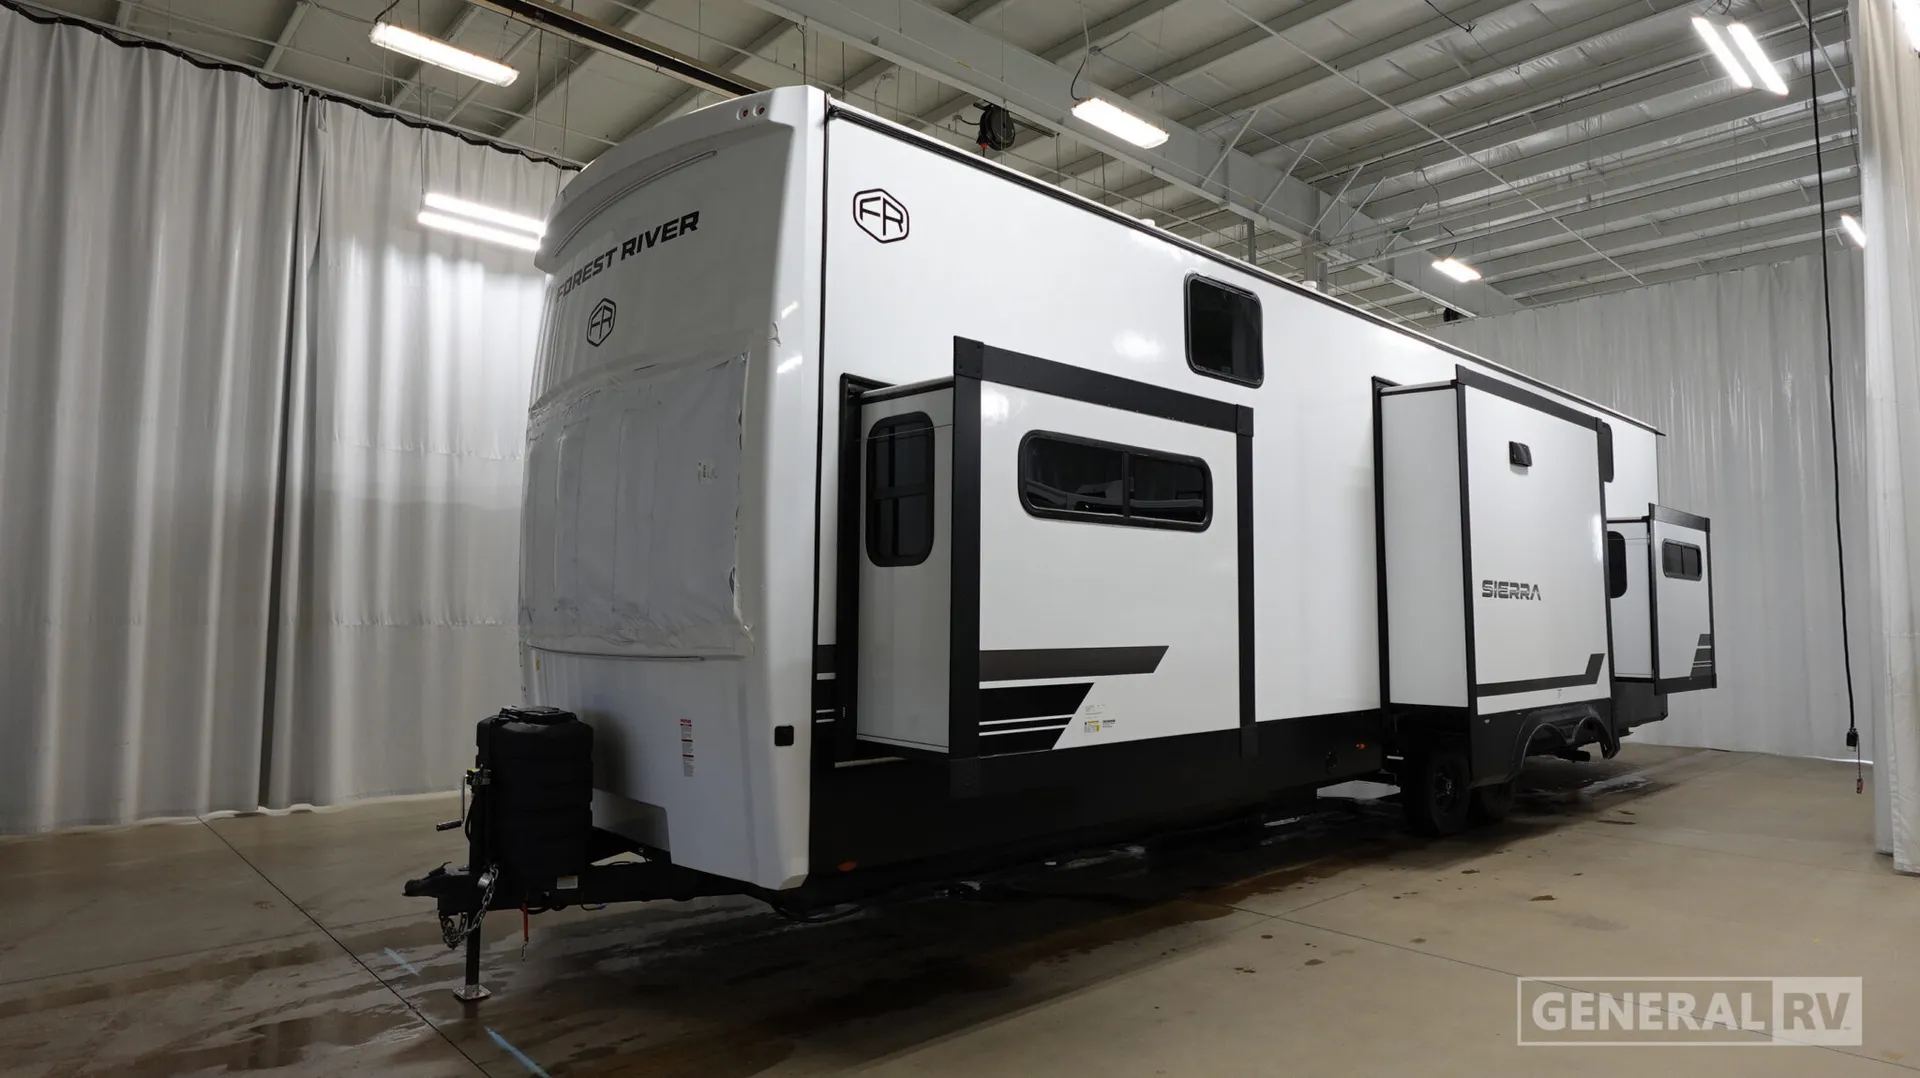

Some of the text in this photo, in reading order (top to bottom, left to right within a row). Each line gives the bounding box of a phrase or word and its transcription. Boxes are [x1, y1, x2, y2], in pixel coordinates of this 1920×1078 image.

[860, 196, 904, 236] FR
[556, 211, 700, 303] FOREST RIVER
[1482, 580, 1541, 601] SIERRA
